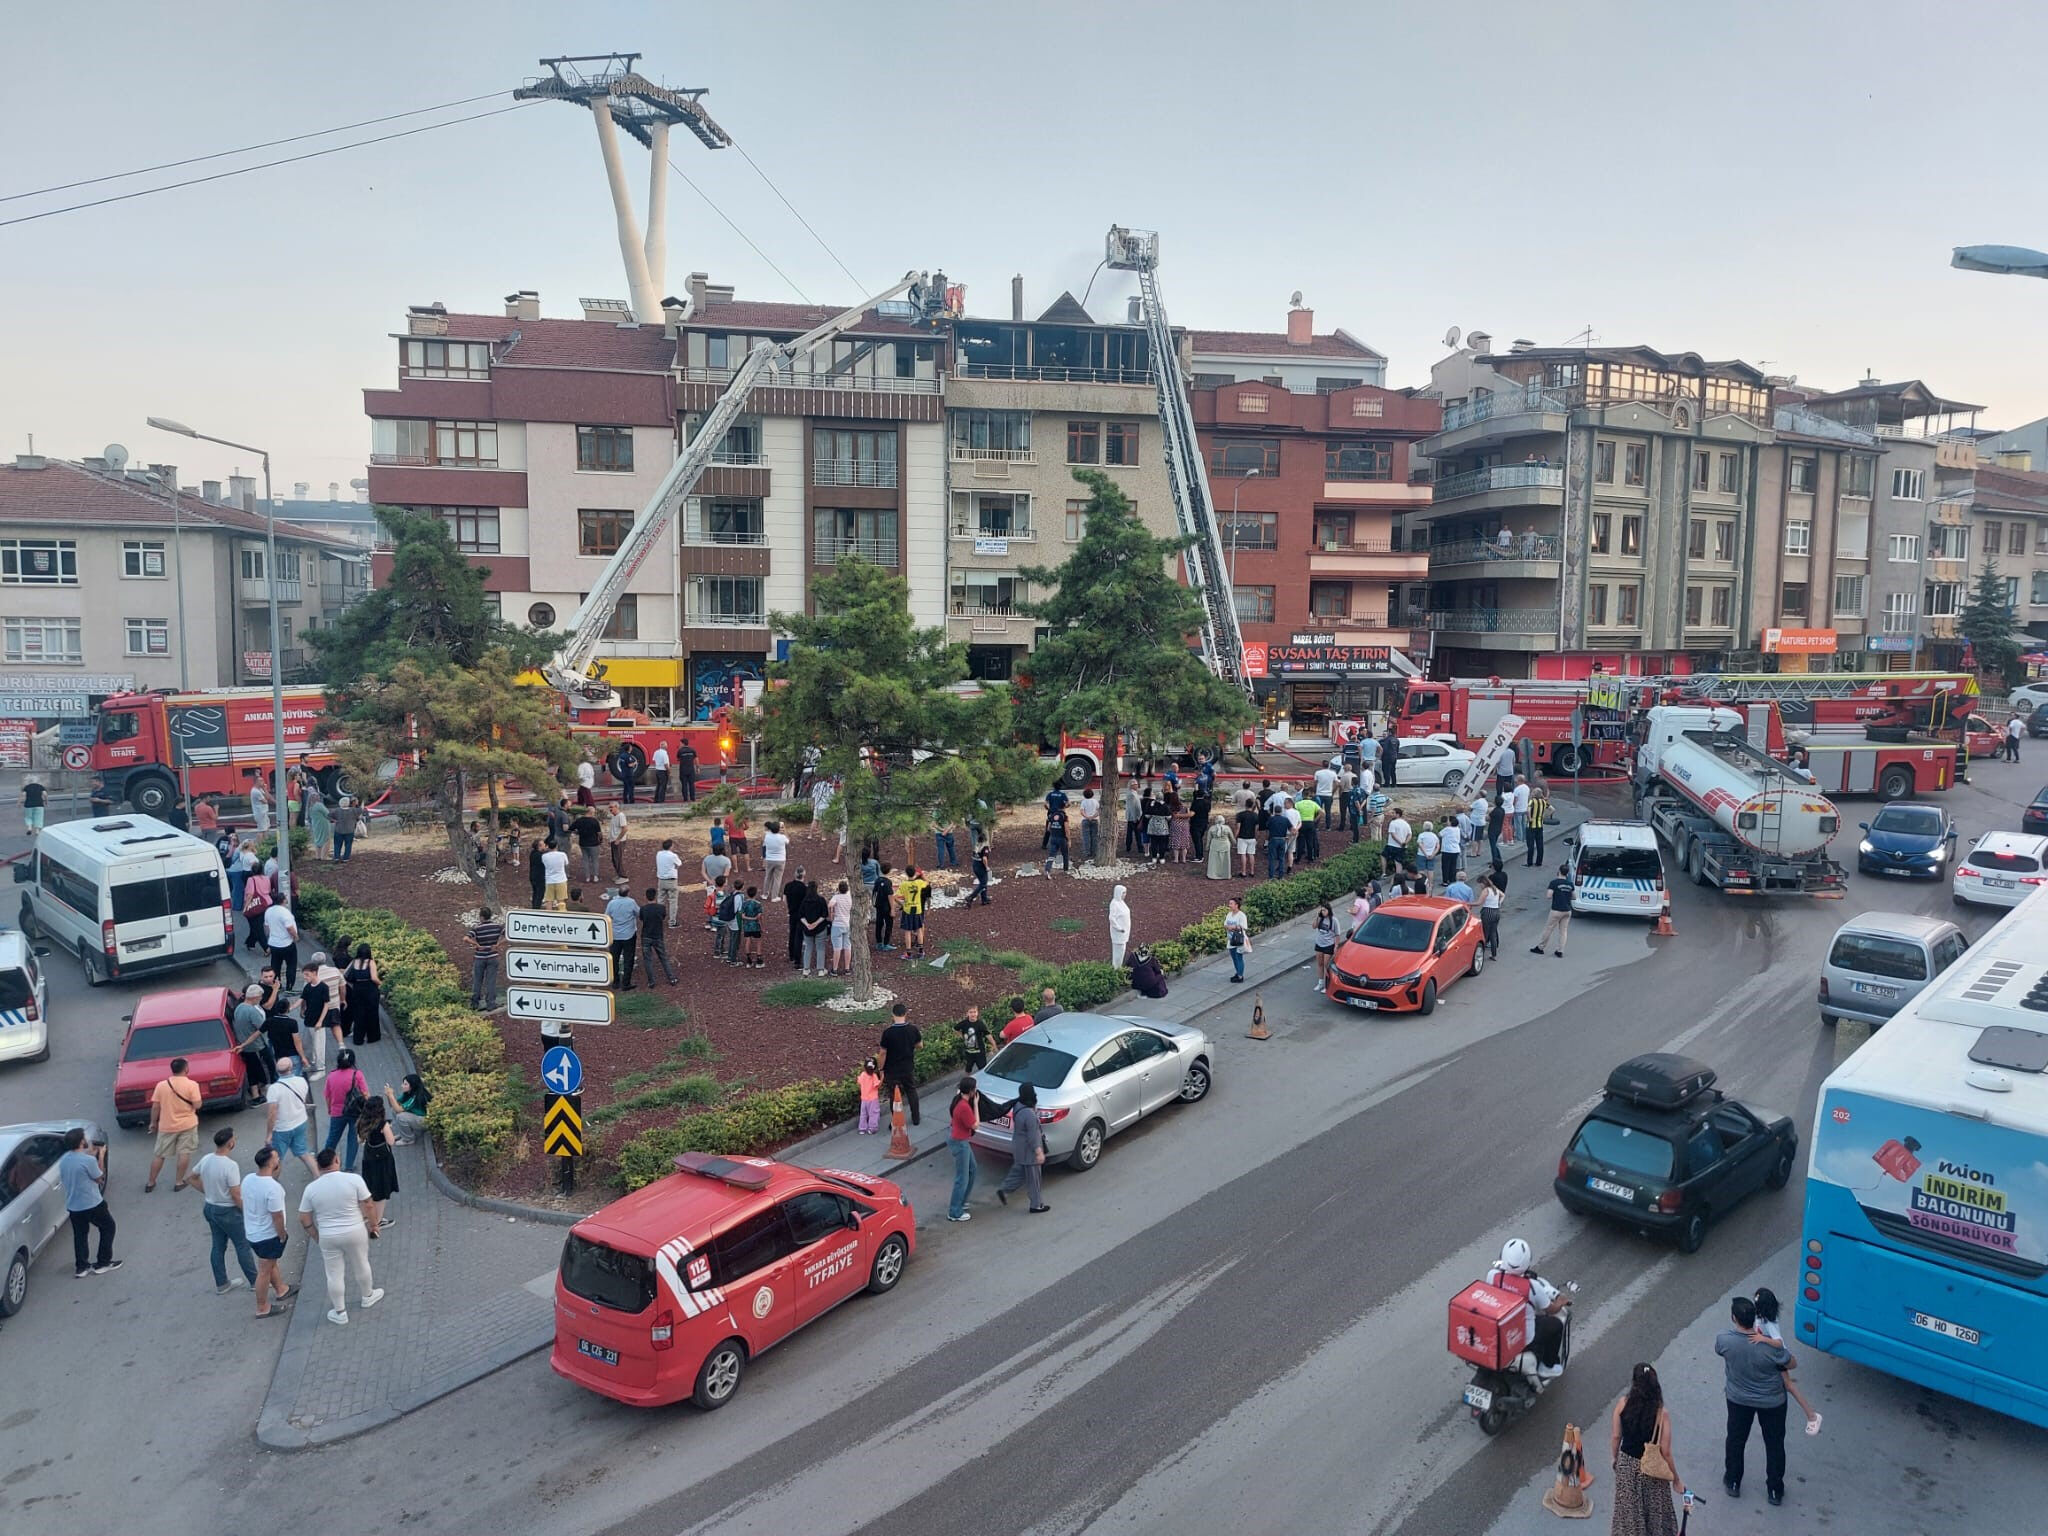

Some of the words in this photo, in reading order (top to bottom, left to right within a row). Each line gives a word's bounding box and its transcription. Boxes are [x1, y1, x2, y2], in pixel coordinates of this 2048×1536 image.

[1781, 636, 1808, 646] NATUREL
[1808, 636, 1819, 646] PET
[1819, 636, 1836, 646] SHOP
[1324, 647, 1350, 661] TAŞ
[1352, 647, 1388, 660] FIRIN
[1309, 661, 1325, 670] SİMİT
[1329, 662, 1347, 670] PASTA
[1351, 662, 1370, 670] EKMEK
[1375, 661, 1388, 670] PİDE
[702, 684, 729, 696] keyfe
[244, 712, 274, 722] ANKAR
[1462, 734, 1506, 797] SİMİT
[909, 890, 918, 902] 7
[513, 920, 579, 935] Demetevler
[533, 959, 601, 974] Yenimahalle
[534, 998, 565, 1012] Ulus
[1832, 1110, 1850, 1121] 202
[1938, 1160, 1994, 1186] mion
[1926, 1175, 2002, 1211] İNDİRİM
[1917, 1194, 2009, 1231] BALONUNU
[1913, 1213, 2013, 1249] SÖNDÜRÜYOR
[804, 1258, 827, 1277] ANKARA
[827, 1239, 858, 1265] BÜYÜKŞEHİR
[689, 1257, 707, 1275] 112
[1916, 1314, 1929, 1326] 06
[1954, 1327, 1978, 1343] 1260
[581, 1340, 589, 1351] 06
[606, 1350, 617, 1362] 231
